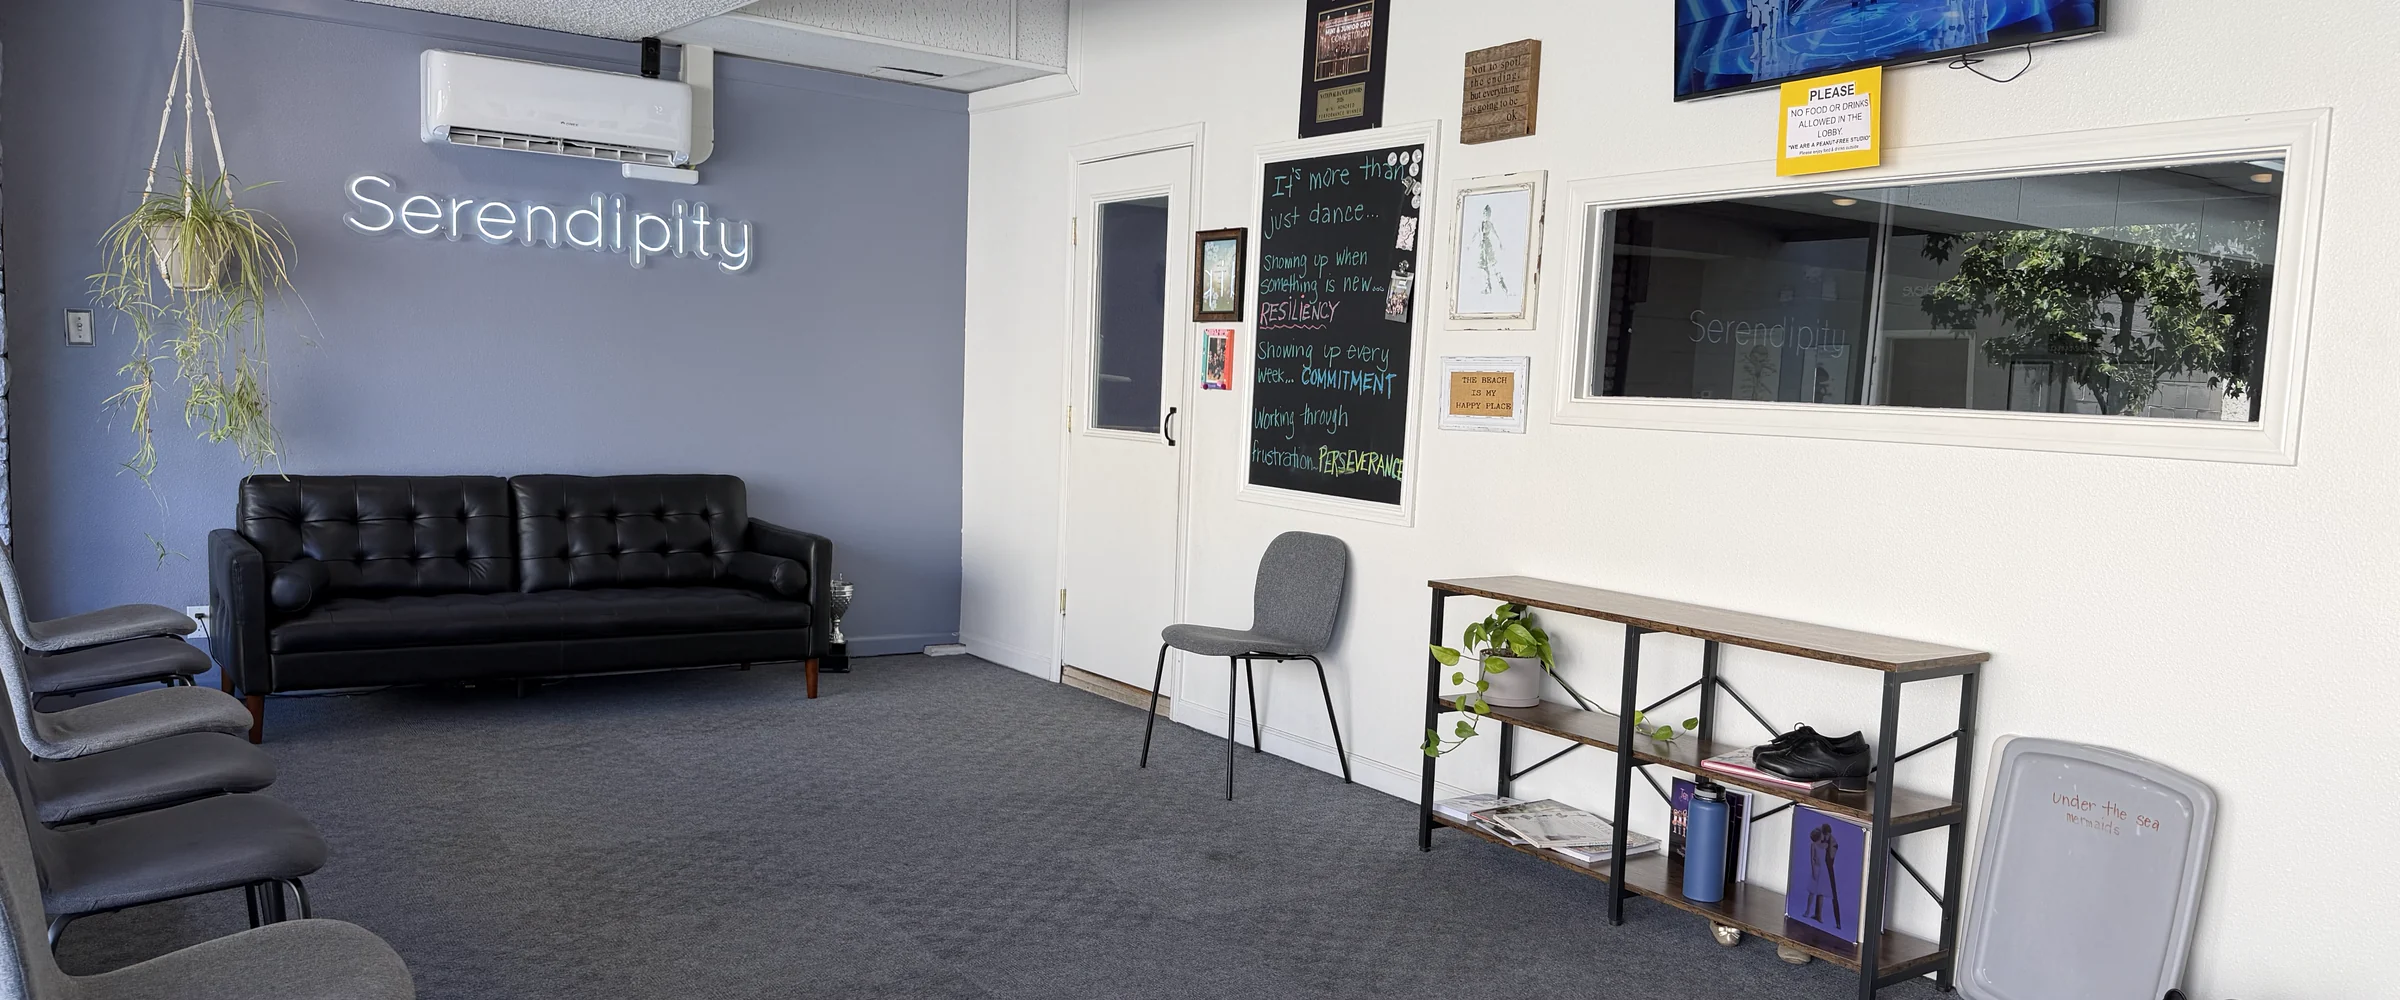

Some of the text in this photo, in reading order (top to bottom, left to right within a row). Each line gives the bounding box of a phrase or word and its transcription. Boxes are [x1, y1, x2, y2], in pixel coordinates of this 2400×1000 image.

[1471, 55, 1521, 75] Not to spoil
[1470, 78, 1484, 88] the
[1470, 83, 1520, 100] but everything
[1809, 84, 1855, 102] PLEASE
[1477, 101, 1498, 114] going
[1500, 99, 1507, 108] to
[1509, 97, 1518, 105] be
[1506, 109, 1517, 121] ok
[1790, 99, 1869, 118] NO FOOD OR DRINKS
[1798, 112, 1862, 129] ALLOWED IN THE
[1816, 137, 1849, 147] PEANUT-FREE
[1272, 167, 1301, 198] It's
[1309, 167, 1350, 191] more
[1359, 155, 1405, 181] than
[350, 175, 749, 271] Serendipity
[1264, 206, 1300, 239] just
[1313, 254, 1329, 279] up
[1260, 271, 1318, 304] something
[1688, 309, 1847, 359] Serendipity
[1257, 340, 1390, 372] Showing up every
[1301, 367, 1397, 399] COMMITMENT
[1462, 376, 1507, 384] THE BEACH
[1471, 389, 1497, 397] IS MY
[1455, 402, 1512, 410] HAPPY PLACE
[1254, 403, 1349, 440] Working through
[1318, 445, 1403, 481] PERSEVERANCE
[2066, 812, 2120, 836] mermaids
[2101, 800, 2128, 820] the
[2136, 814, 2160, 832] sea
